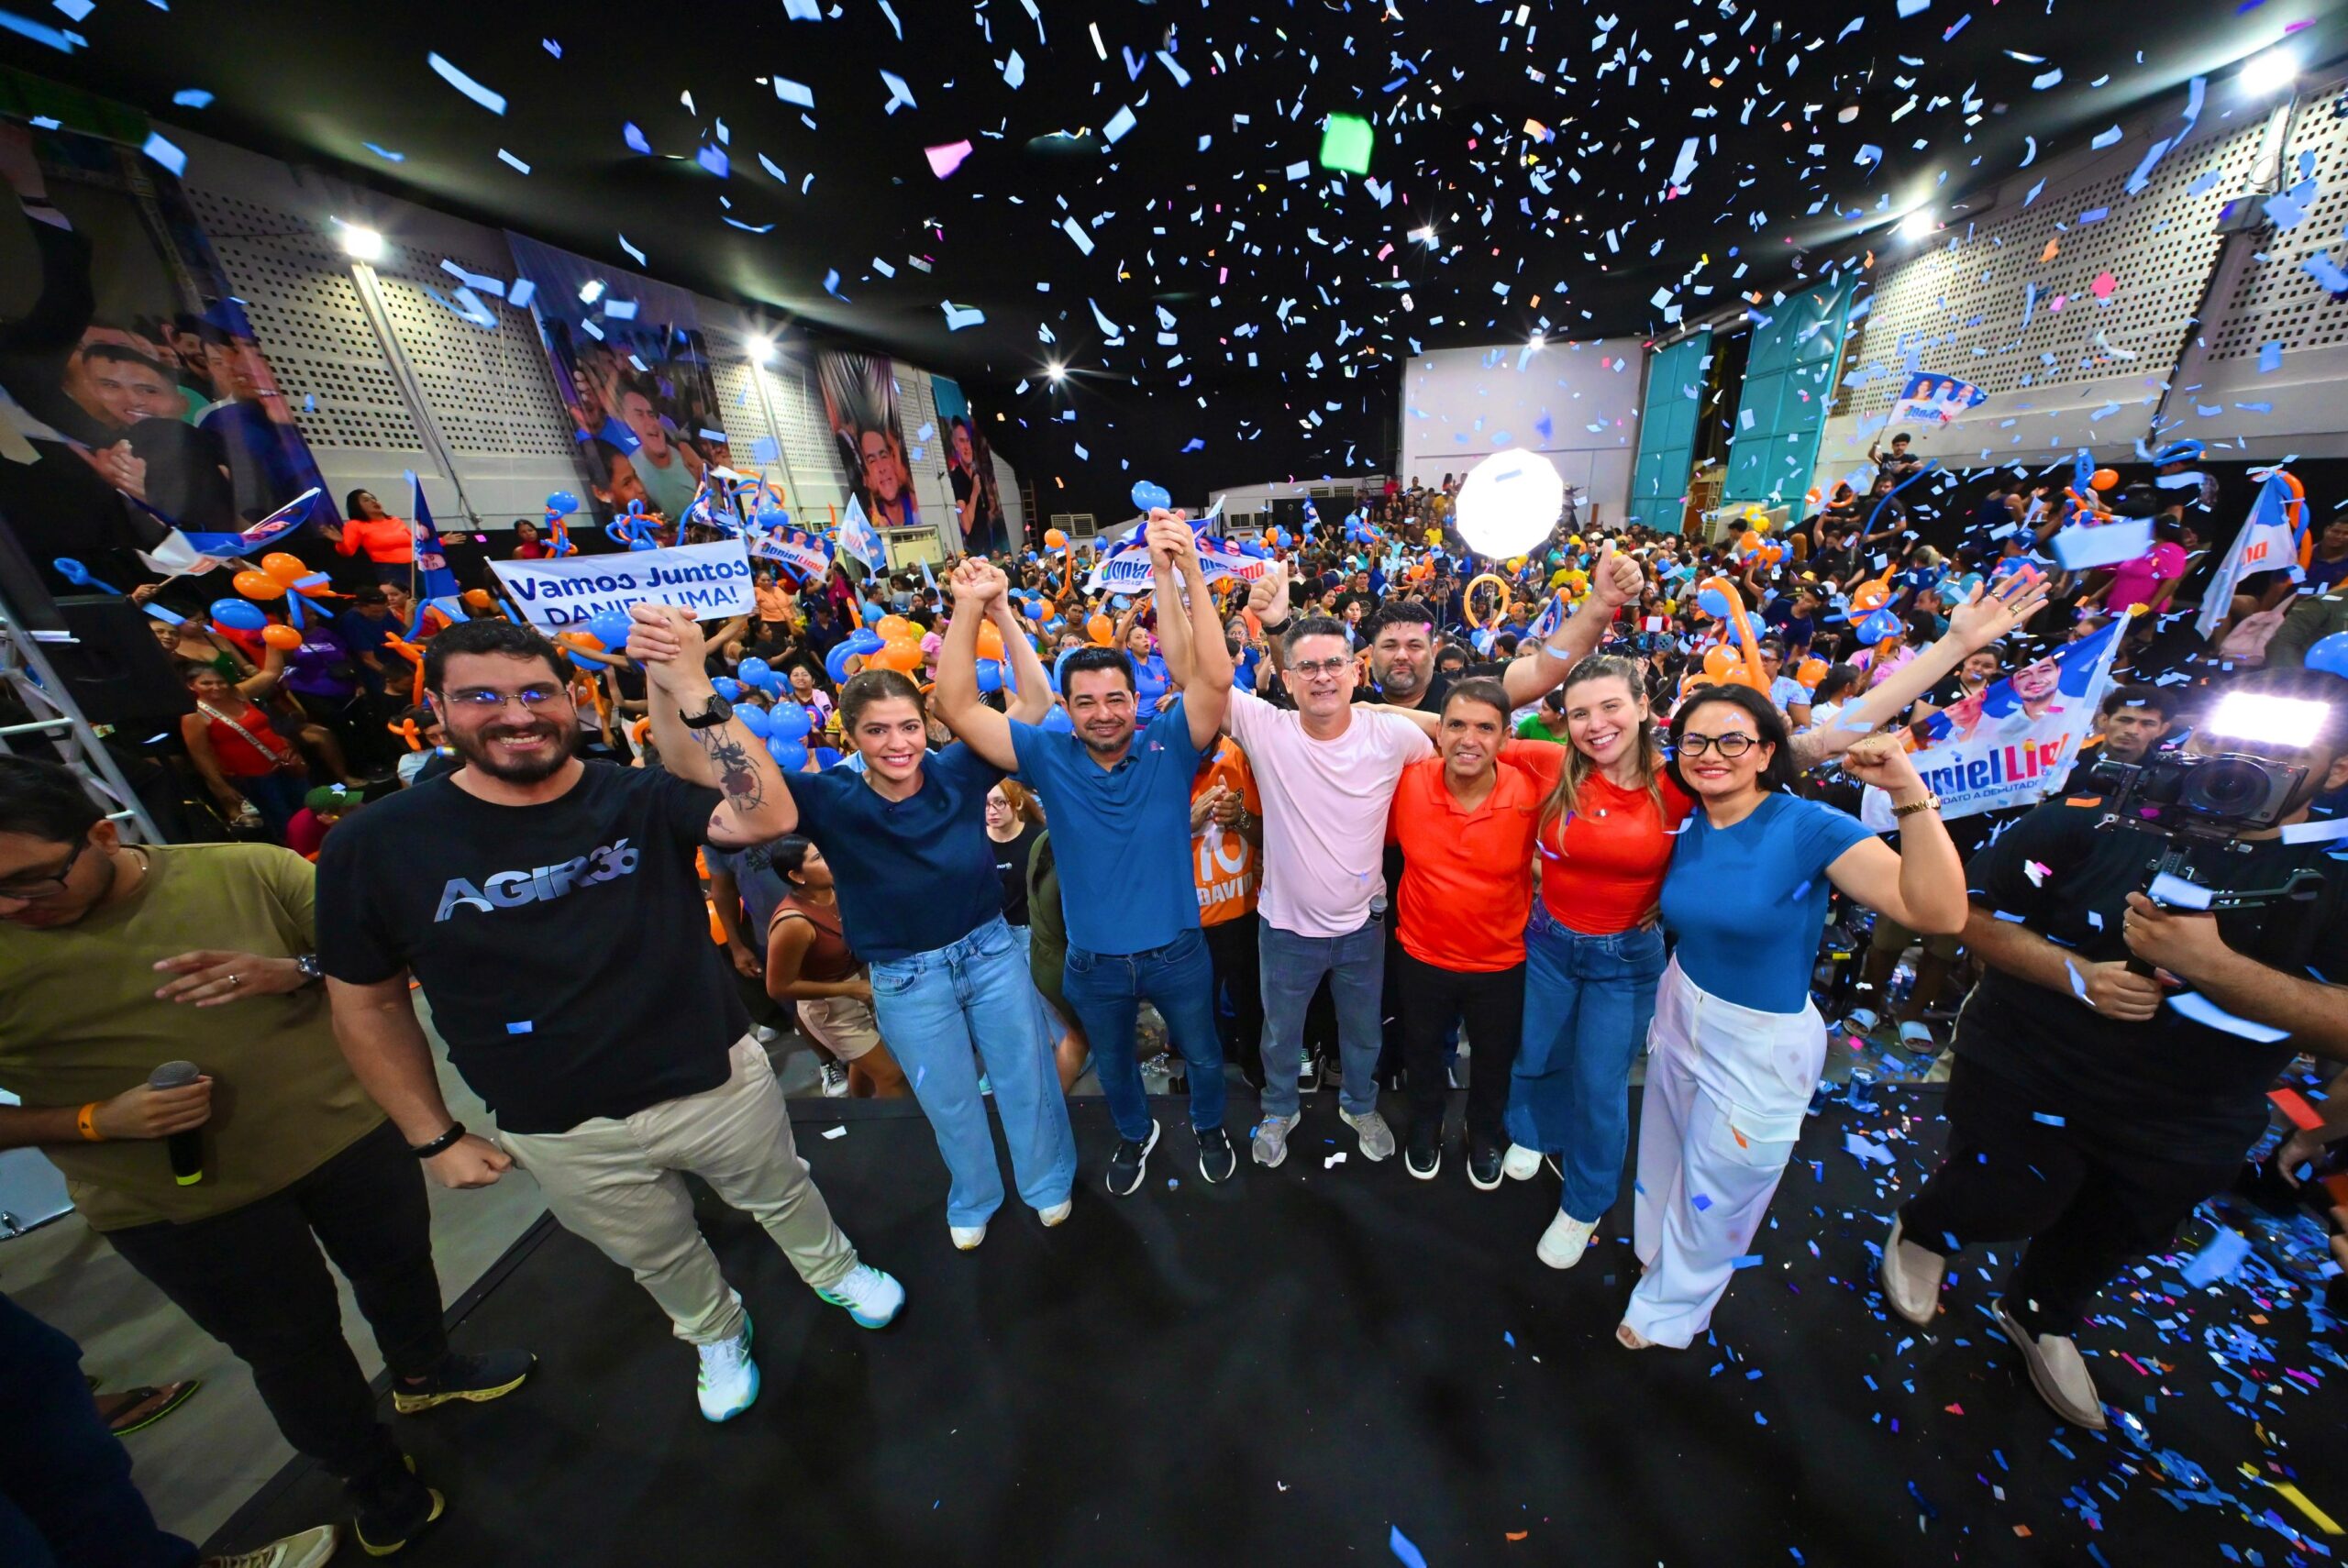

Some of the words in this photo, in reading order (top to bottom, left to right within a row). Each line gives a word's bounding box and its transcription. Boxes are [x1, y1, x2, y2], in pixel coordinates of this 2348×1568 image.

[509, 573, 637, 602] Vamos
[646, 559, 749, 588] Juntos
[1921, 749, 2001, 796] niel
[1974, 791, 1981, 800] A
[434, 838, 639, 922] AGIR36
[1197, 872, 1253, 907] DAVID
